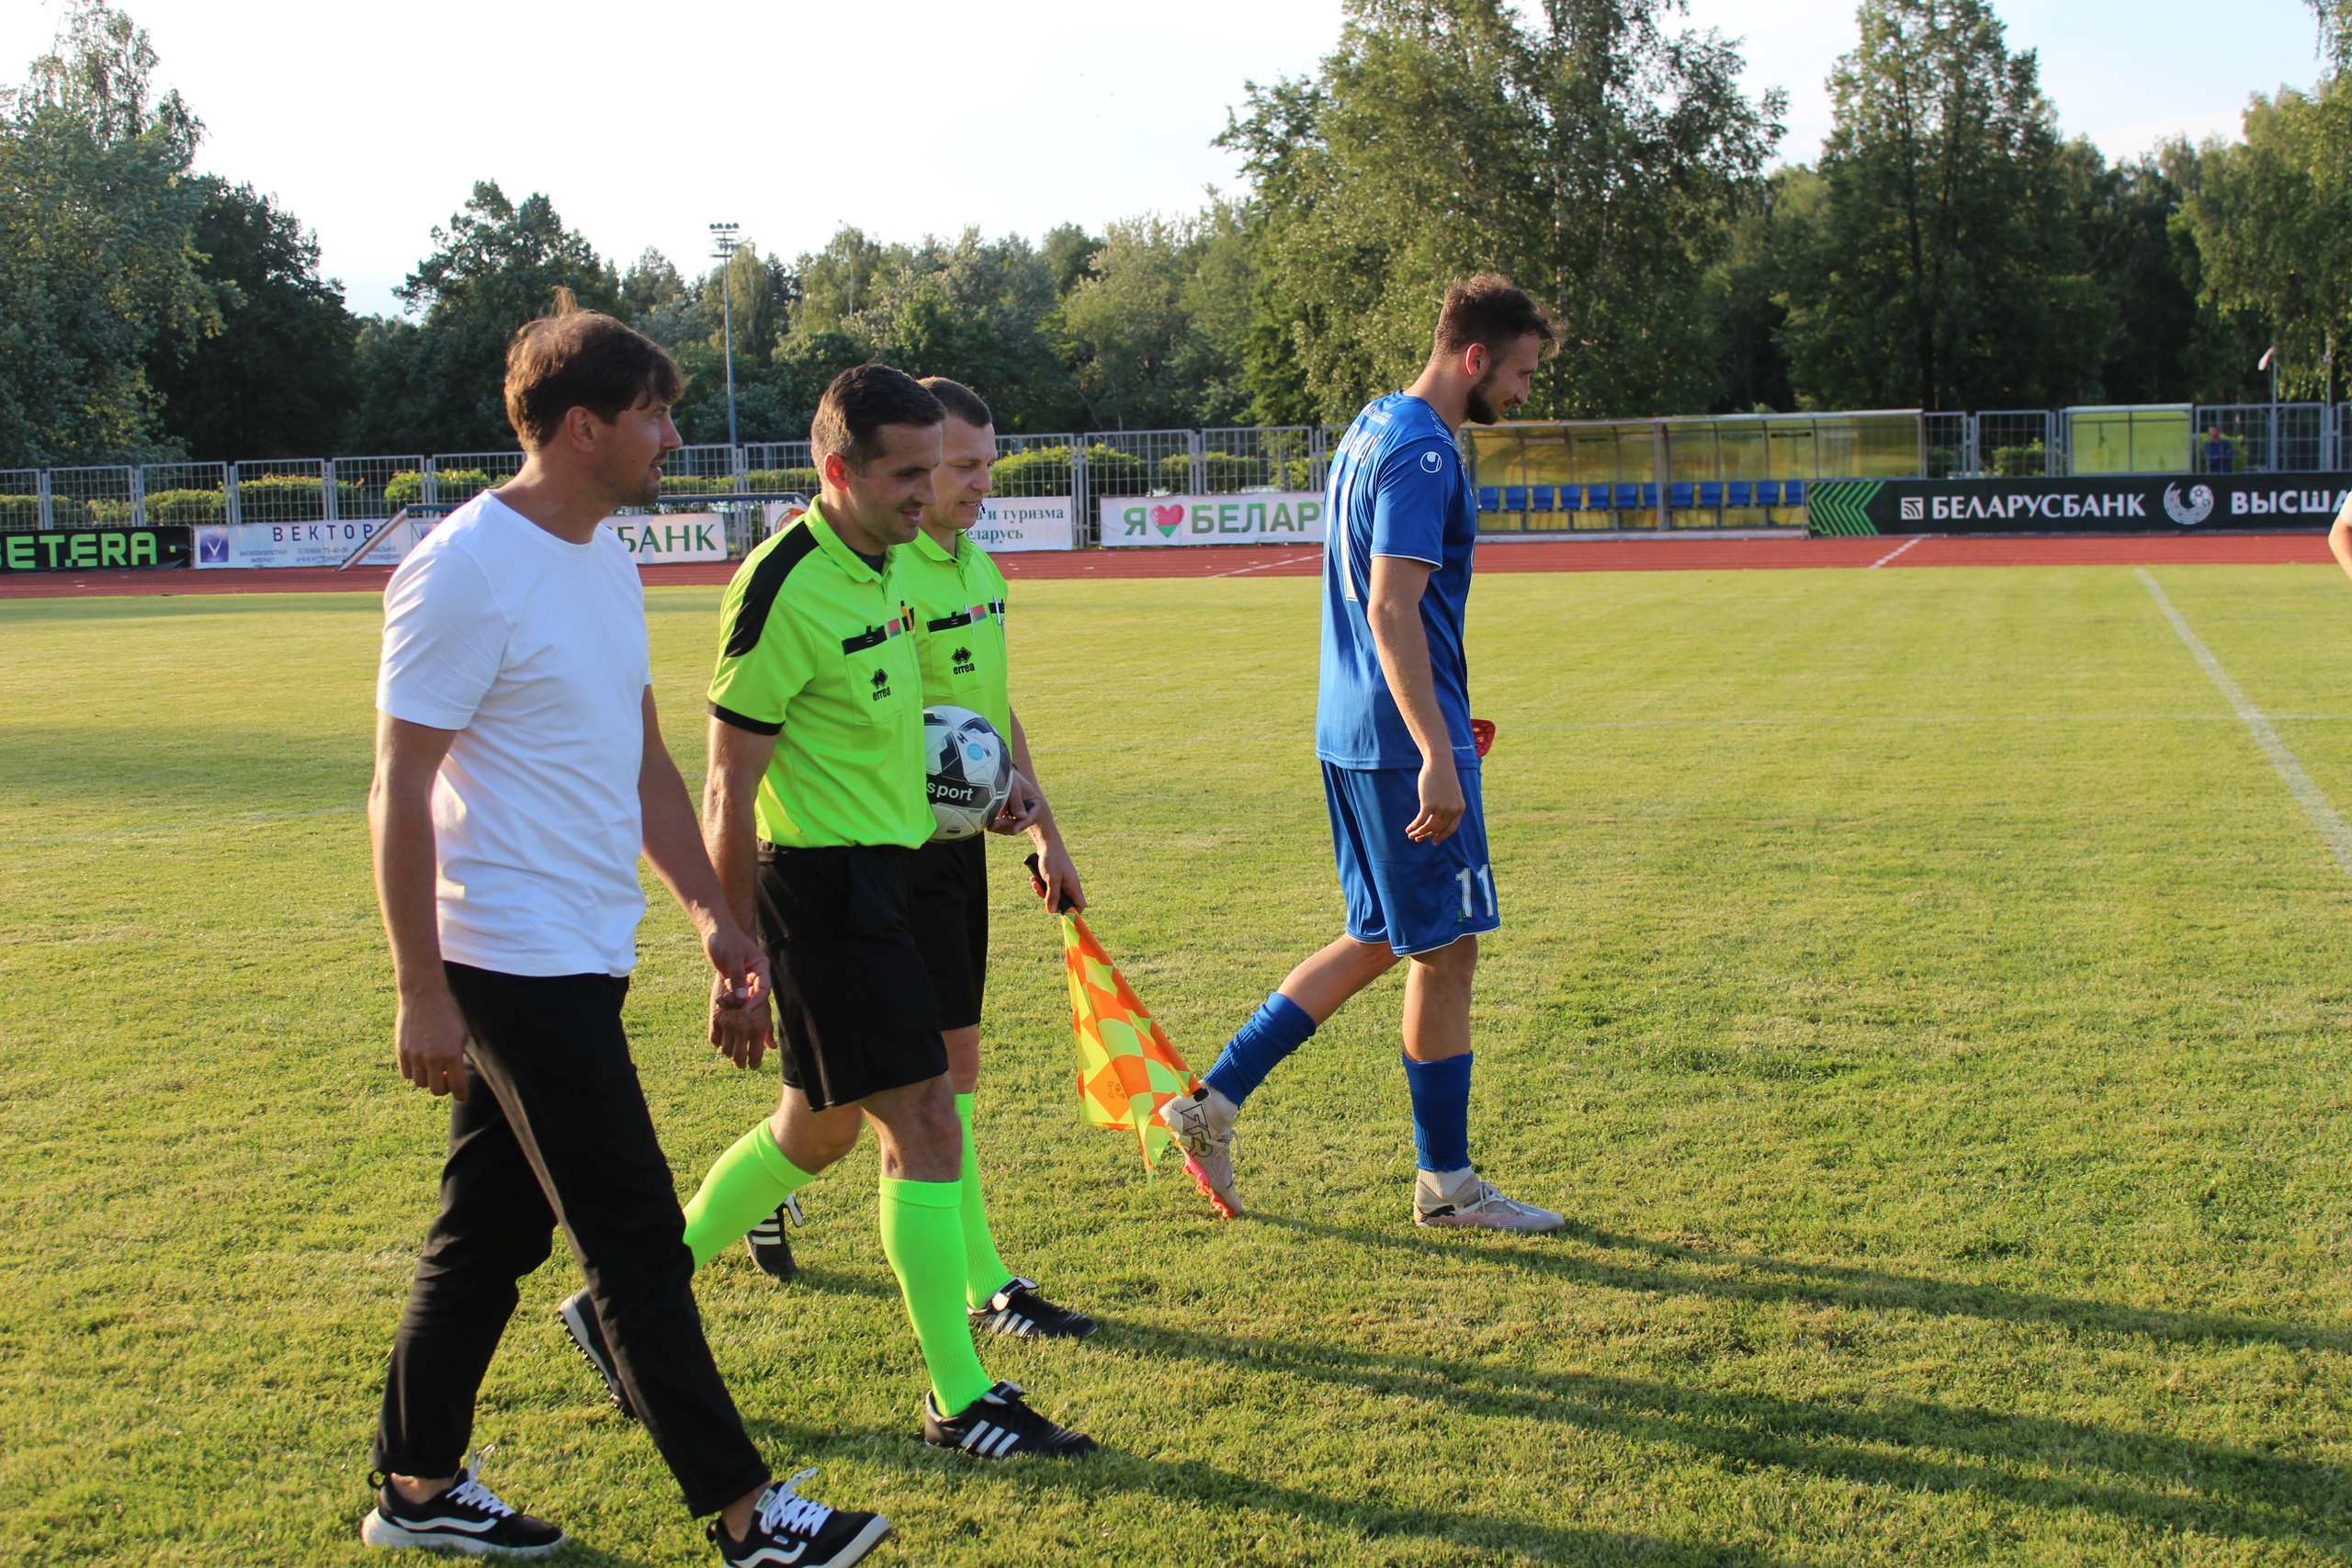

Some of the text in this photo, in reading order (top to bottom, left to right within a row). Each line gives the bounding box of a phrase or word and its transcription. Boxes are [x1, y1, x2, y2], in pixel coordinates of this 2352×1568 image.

[1001, 508, 1064, 524] туризма
[1124, 502, 1322, 536] Я БЕЛАР
[1932, 493, 2146, 520] БЕЛАРУСБАНК
[0, 532, 157, 569] ETERA
[616, 524, 718, 553] БАНК
[967, 529, 1023, 544] еларусь
[1455, 864, 1494, 918] 11
